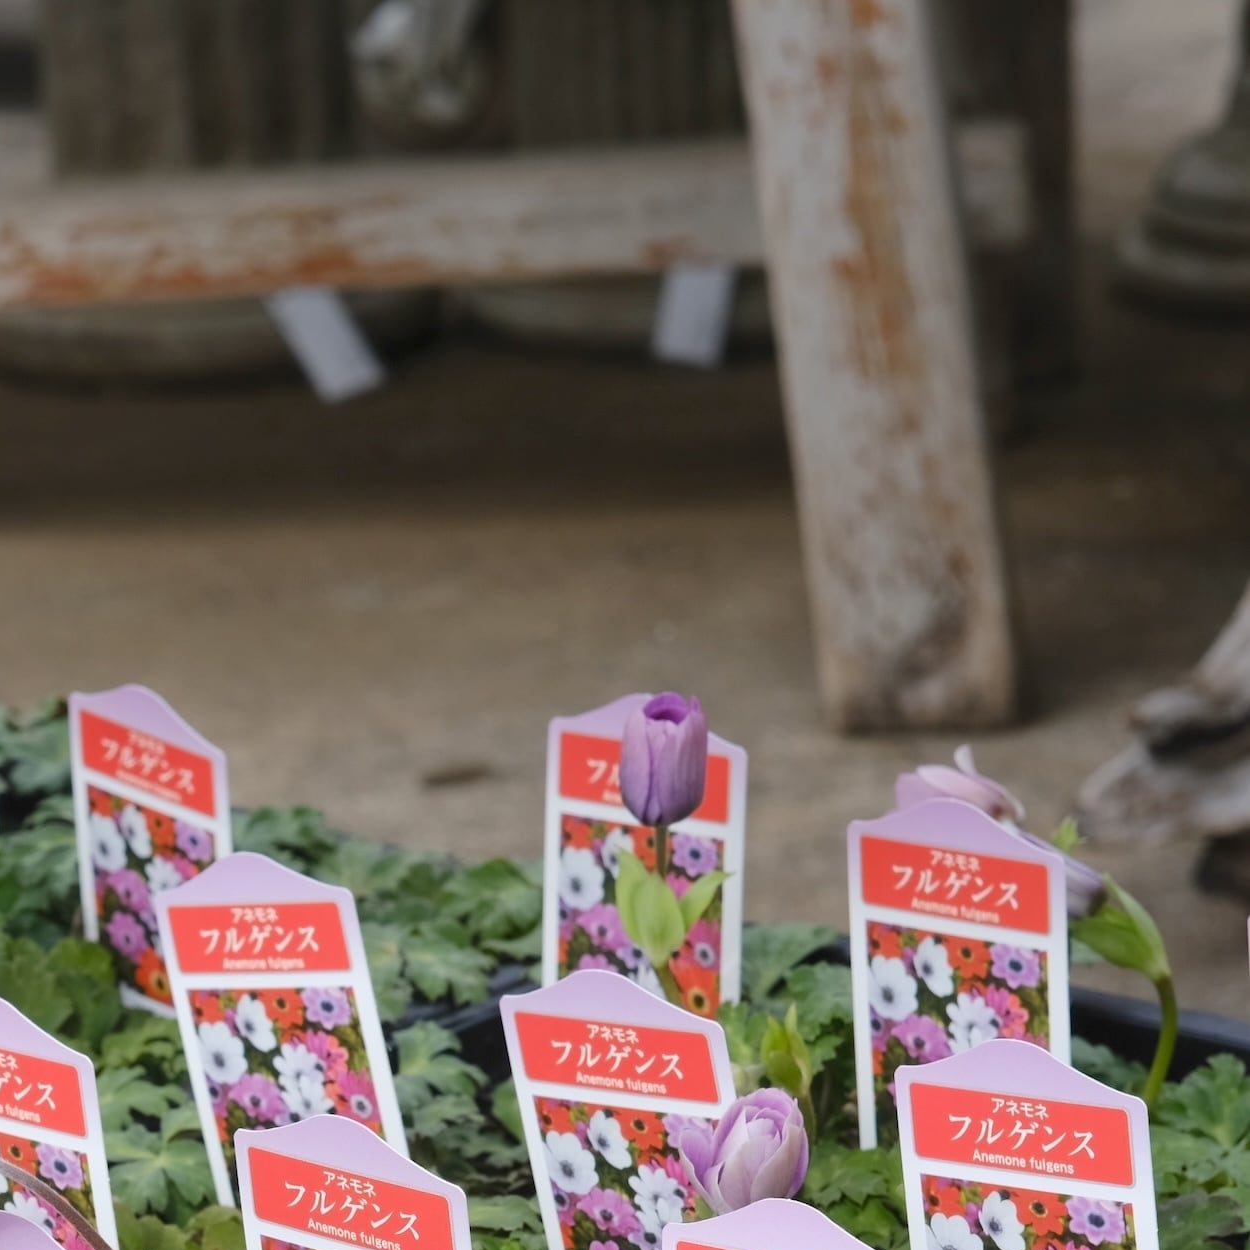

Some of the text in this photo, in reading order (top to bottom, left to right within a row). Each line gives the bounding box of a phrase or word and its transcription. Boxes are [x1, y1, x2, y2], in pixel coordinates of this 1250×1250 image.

[101, 738, 194, 793] フルゲンス
[930, 850, 981, 872] アネモネ
[892, 864, 1018, 909] フルゲンス
[230, 907, 278, 923] アネモネ
[200, 924, 319, 954] フルゲンス
[586, 1024, 640, 1045] アネモネ
[551, 1040, 684, 1080] フルゲンス
[575, 1071, 667, 1094] Anemone fulgens
[5, 1103, 41, 1123] fulgens
[990, 1097, 1049, 1120] アネモネ
[948, 1114, 1096, 1159] フルゲンス
[972, 1148, 1075, 1175] Anemone fulgens
[322, 1170, 377, 1198] アネモネ
[284, 1181, 420, 1241] フルゲンス
[307, 1217, 358, 1242] Anemone
